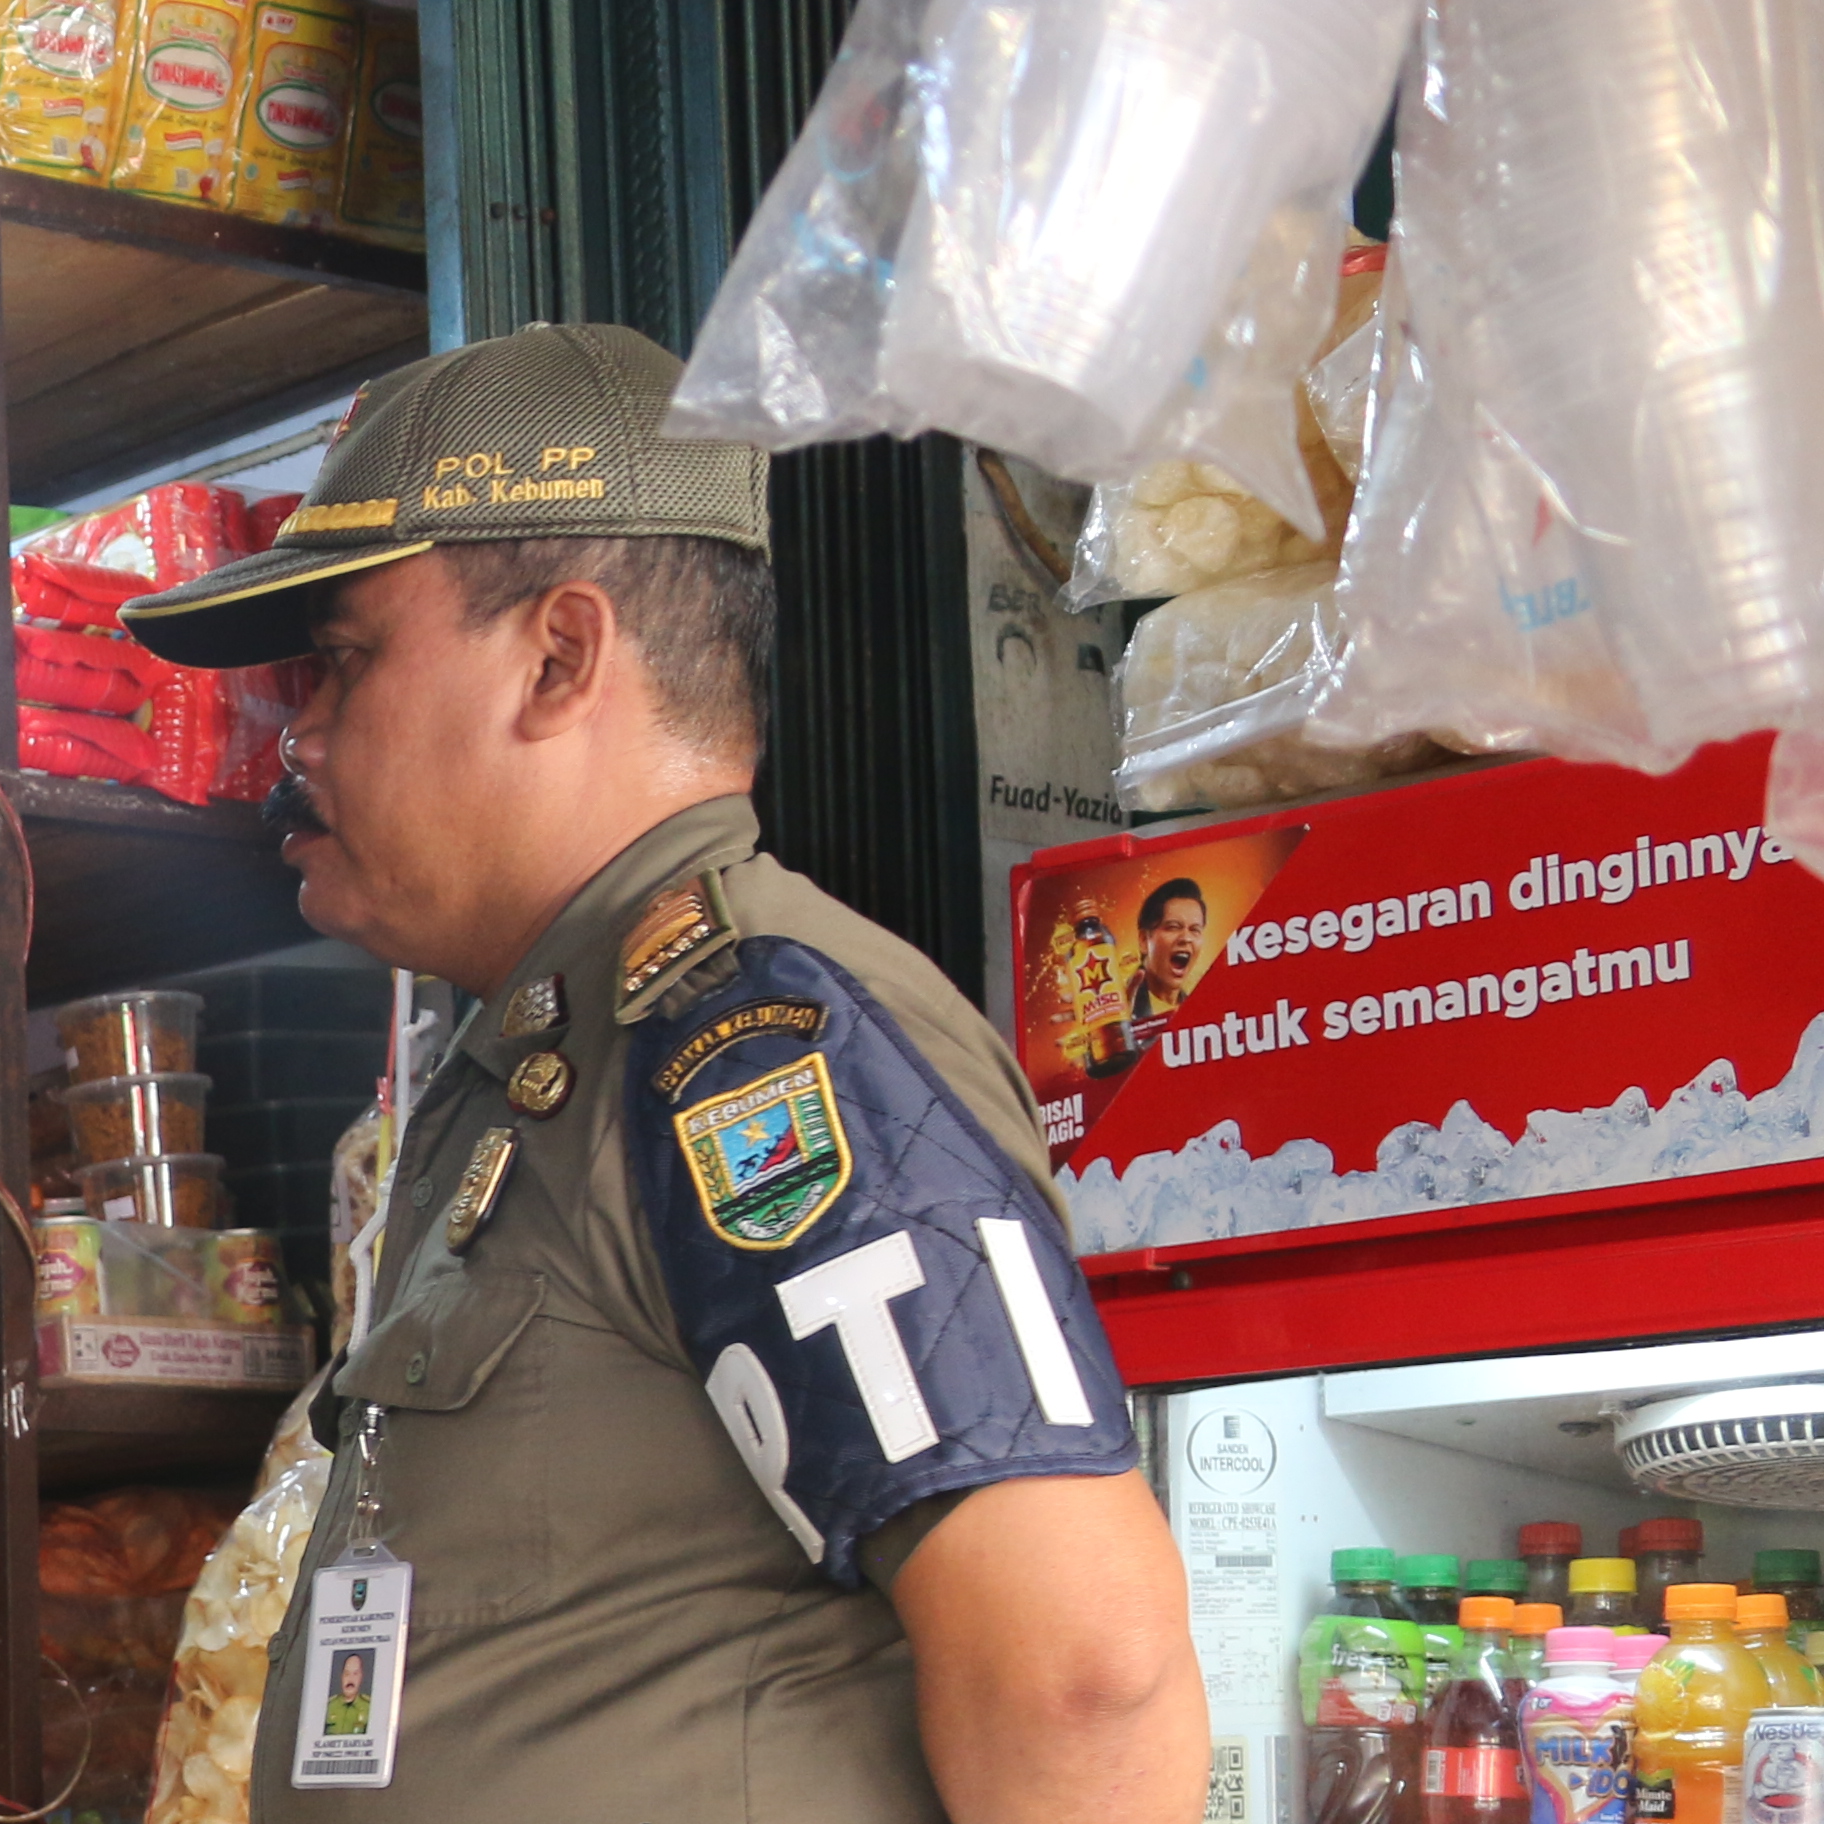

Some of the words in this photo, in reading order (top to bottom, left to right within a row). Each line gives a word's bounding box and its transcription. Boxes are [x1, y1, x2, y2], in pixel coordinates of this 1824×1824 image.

[435, 452, 513, 480] POL
[540, 446, 596, 471] PP
[423, 482, 475, 510] Kab.
[490, 475, 605, 504] Kebumen
[1509, 821, 1794, 911] dinginnya
[1161, 991, 1305, 1068] untuk
[1324, 940, 1692, 1040] semangatmu
[688, 1069, 815, 1136] KEBUMEN
[1200, 1457, 1266, 1473] INTERCOOL
[1217, 1444, 1249, 1455] SANDEN
[1534, 1736, 1615, 1766] MILK
[1638, 1799, 1666, 1813] Maid
